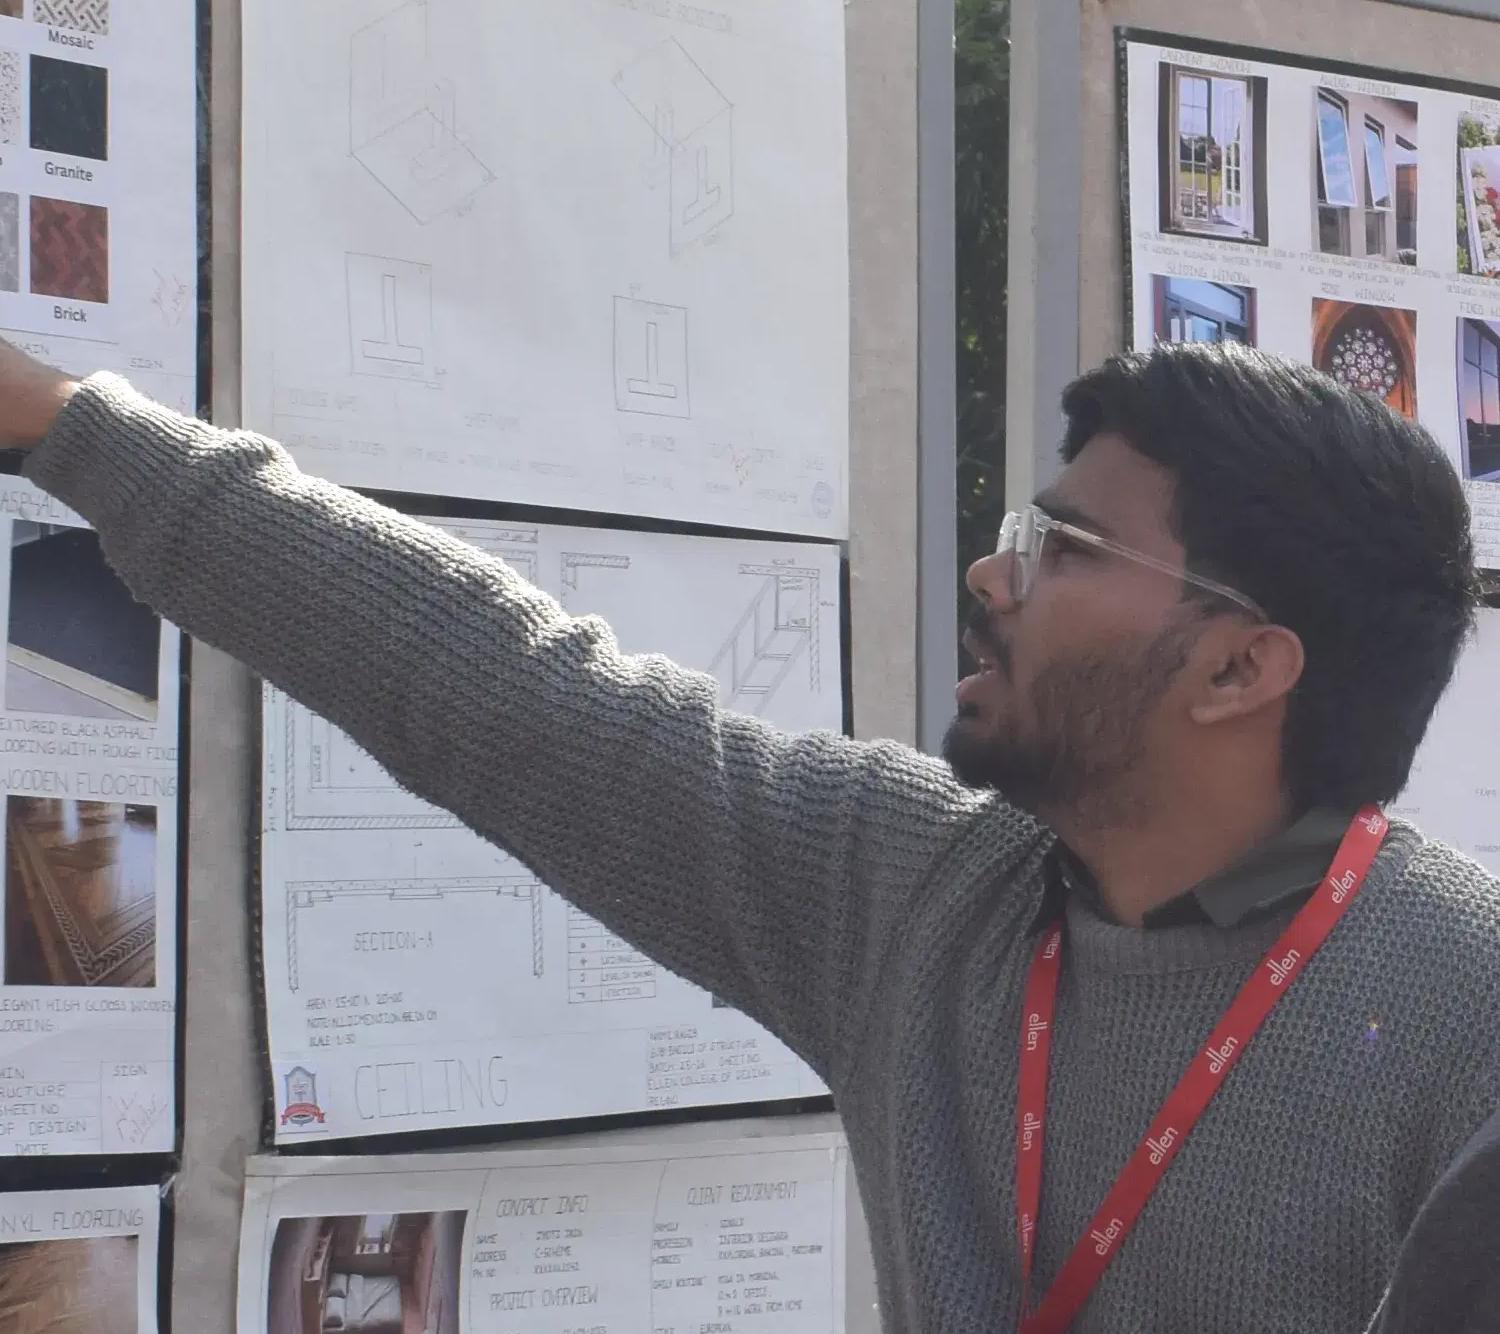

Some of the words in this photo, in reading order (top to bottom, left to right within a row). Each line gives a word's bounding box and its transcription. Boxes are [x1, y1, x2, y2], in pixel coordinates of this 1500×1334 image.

[49, 30, 94, 49] Mosaic
[45, 162, 93, 181] Granite
[54, 306, 86, 322] Brick
[62, 722, 99, 737] BLACK
[104, 724, 157, 741] ASPHALT
[77, 773, 177, 797] FLOORING
[1332, 868, 1357, 904] ellen
[1270, 948, 1301, 986] ellen
[46, 1000, 79, 1012] HIGH
[1028, 1013, 1048, 1051] ellen
[1208, 1036, 1239, 1074] ellen
[113, 1066, 147, 1076] SIGN
[355, 1056, 507, 1120] CEILING
[30, 1121, 86, 1136] DESIGN
[1022, 1112, 1041, 1150] ellen
[1149, 1126, 1179, 1165] ellen
[54, 1209, 143, 1231] FLOORING
[1095, 1218, 1123, 1256] ellen
